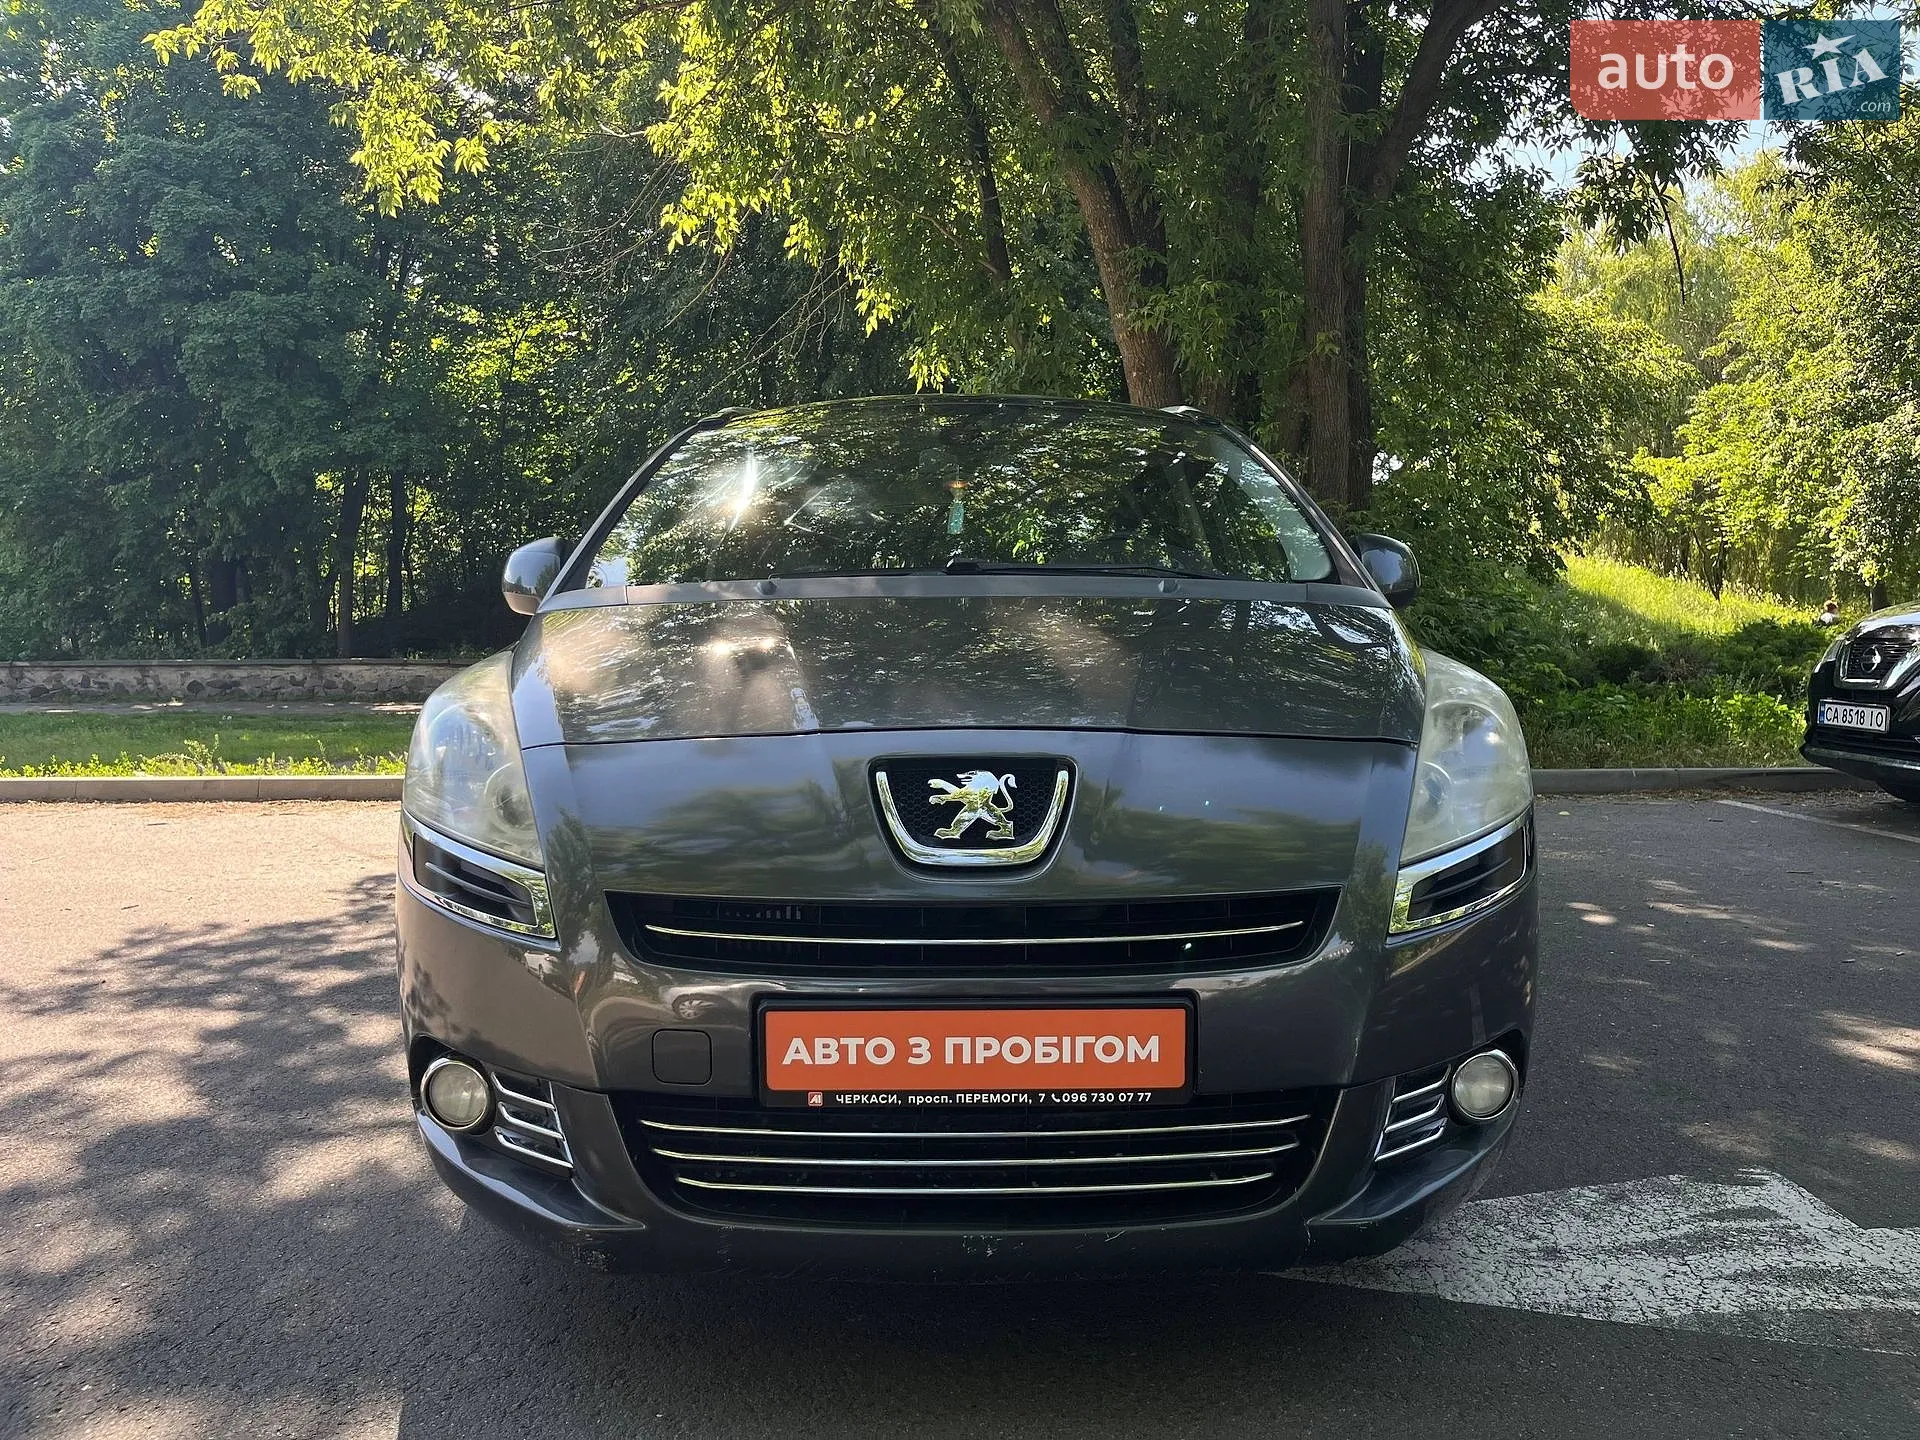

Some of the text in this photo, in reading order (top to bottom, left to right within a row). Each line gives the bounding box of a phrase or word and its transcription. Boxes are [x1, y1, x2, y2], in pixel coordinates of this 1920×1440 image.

[1826, 707, 1838, 723] CA
[1842, 708, 1865, 725] 8518
[1870, 711, 1883, 727] IO
[782, 1035, 1160, 1065] АВТО З ПРОБІГОМ
[836, 1092, 1152, 1106] ЧЕРКАСИ, просп. ПЕРЕМОГИ, 7 096 730 07 77
